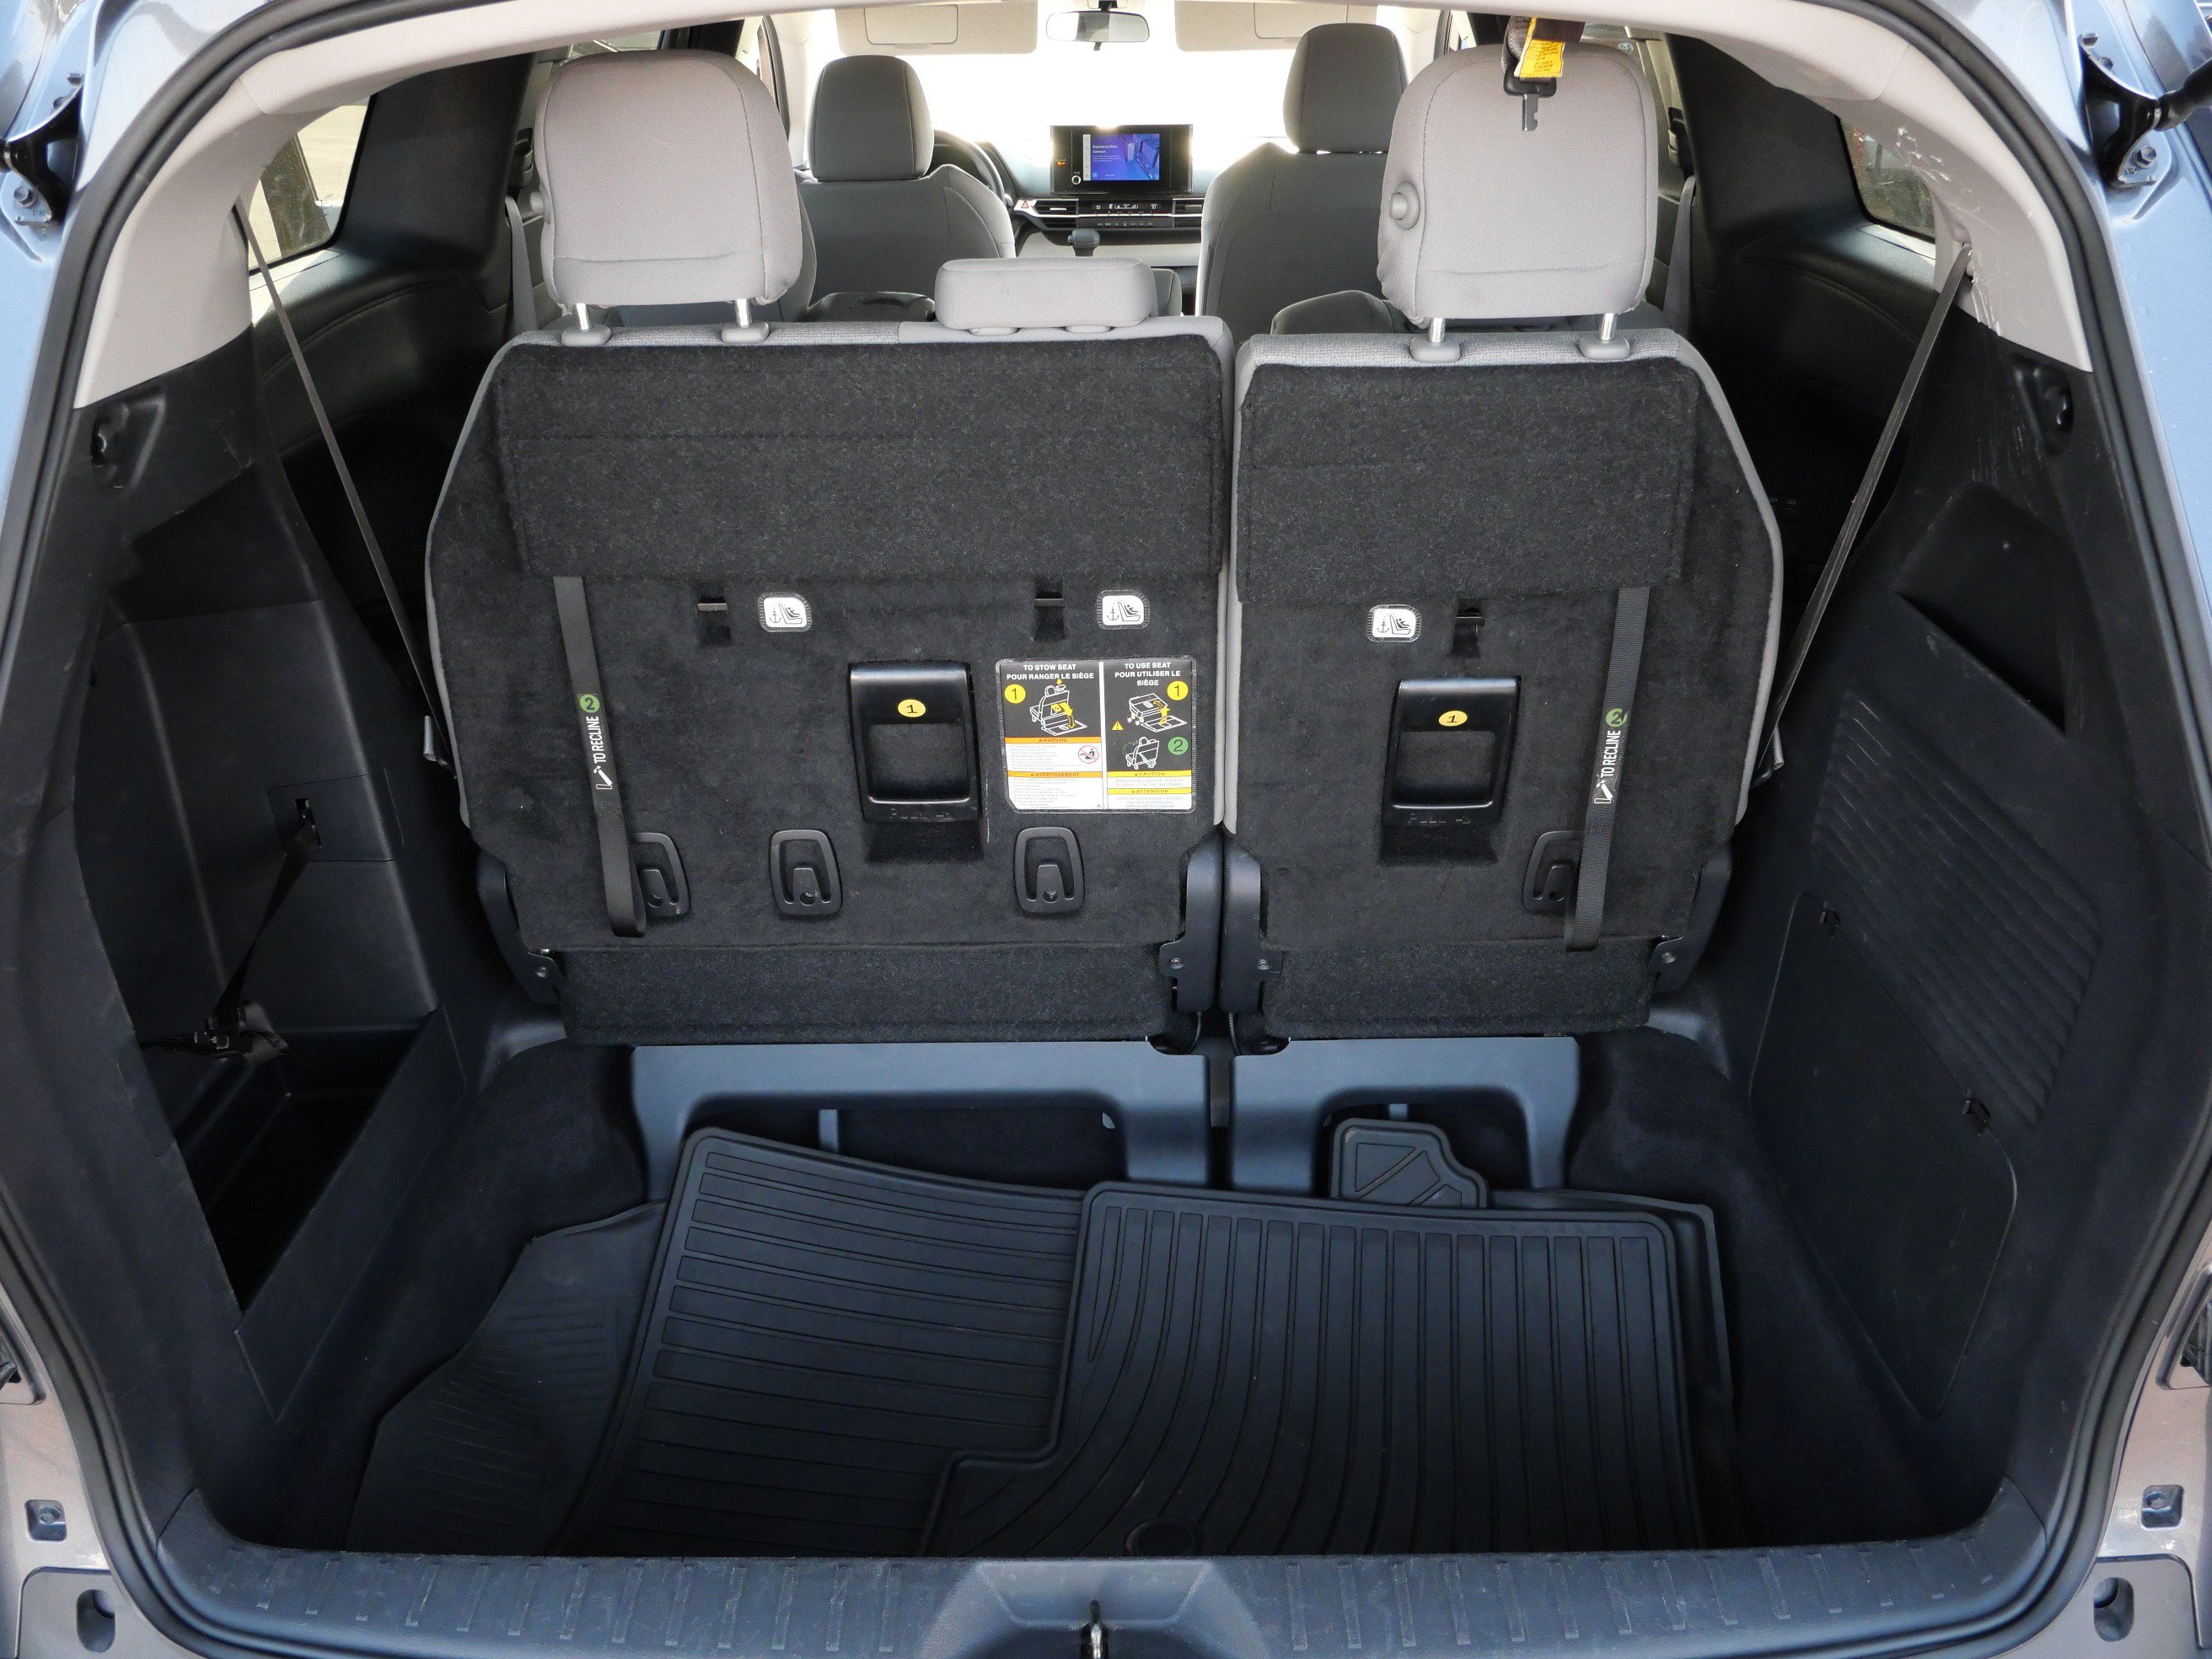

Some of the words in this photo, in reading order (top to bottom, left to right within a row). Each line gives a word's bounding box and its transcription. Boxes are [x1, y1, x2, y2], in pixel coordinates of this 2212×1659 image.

[1012, 688, 1017, 700] 1
[1174, 685, 1179, 697] 1
[584, 697, 595, 710] 2
[907, 705, 917, 713] 1
[1611, 711, 1621, 724] 2
[586, 717, 604, 751] RECLINE
[1173, 739, 1183, 751] 2
[1603, 730, 1621, 765] RECLINE
[593, 753, 607, 764] TO
[1601, 767, 1615, 777] TO
